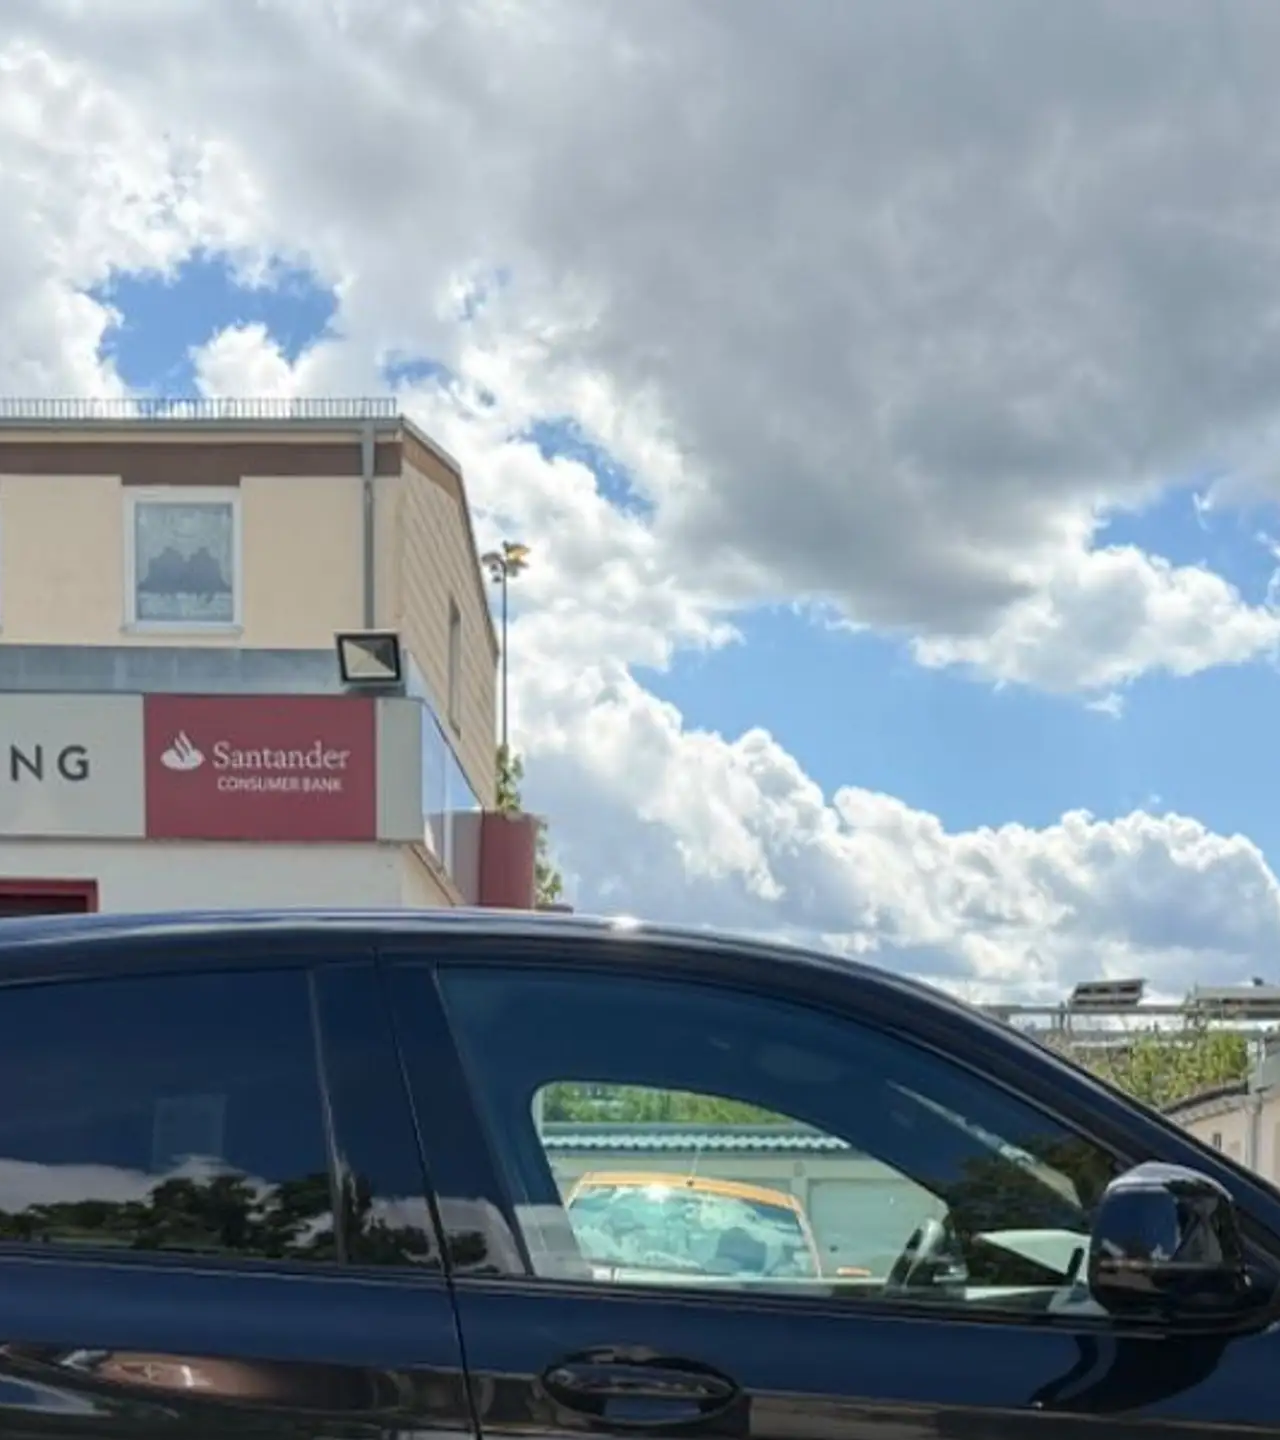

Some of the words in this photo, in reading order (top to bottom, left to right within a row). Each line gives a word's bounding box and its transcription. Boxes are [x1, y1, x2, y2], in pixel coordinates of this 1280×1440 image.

[212, 740, 350, 770] Santander
[217, 775, 300, 792] CONSUMER
[303, 776, 343, 793] BANK
